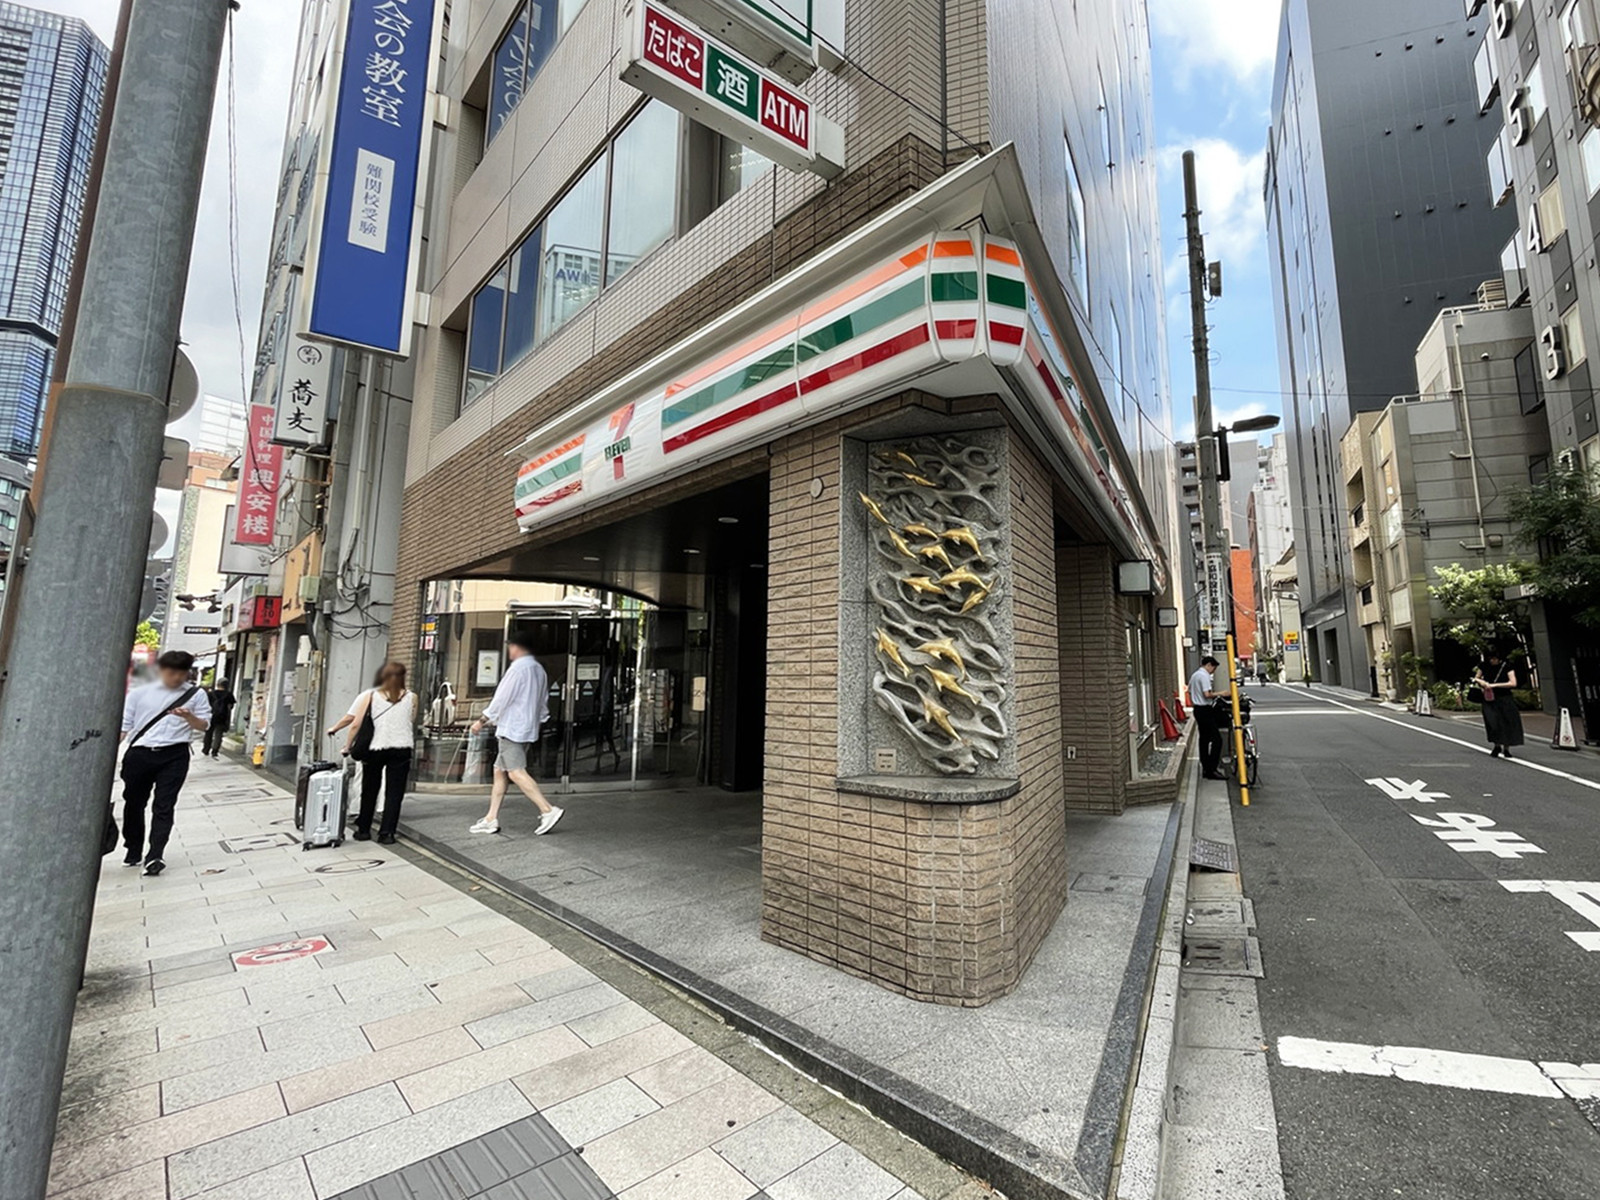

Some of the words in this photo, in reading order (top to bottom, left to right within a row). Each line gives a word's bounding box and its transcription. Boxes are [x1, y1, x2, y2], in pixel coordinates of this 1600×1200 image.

[360, 0, 413, 128] 会の教室
[647, 20, 700, 78] たばこ
[717, 59, 749, 107] 酒
[764, 90, 806, 140] ATM
[1507, 87, 1528, 147] 5
[359, 163, 383, 237] 難関校受験
[1527, 203, 1542, 254] 4
[1541, 326, 1565, 380] 3
[286, 378, 320, 434] 蕎麦
[256, 414, 274, 465] 中国料理
[609, 402, 635, 480] 7
[242, 469, 276, 536] 興安楼
